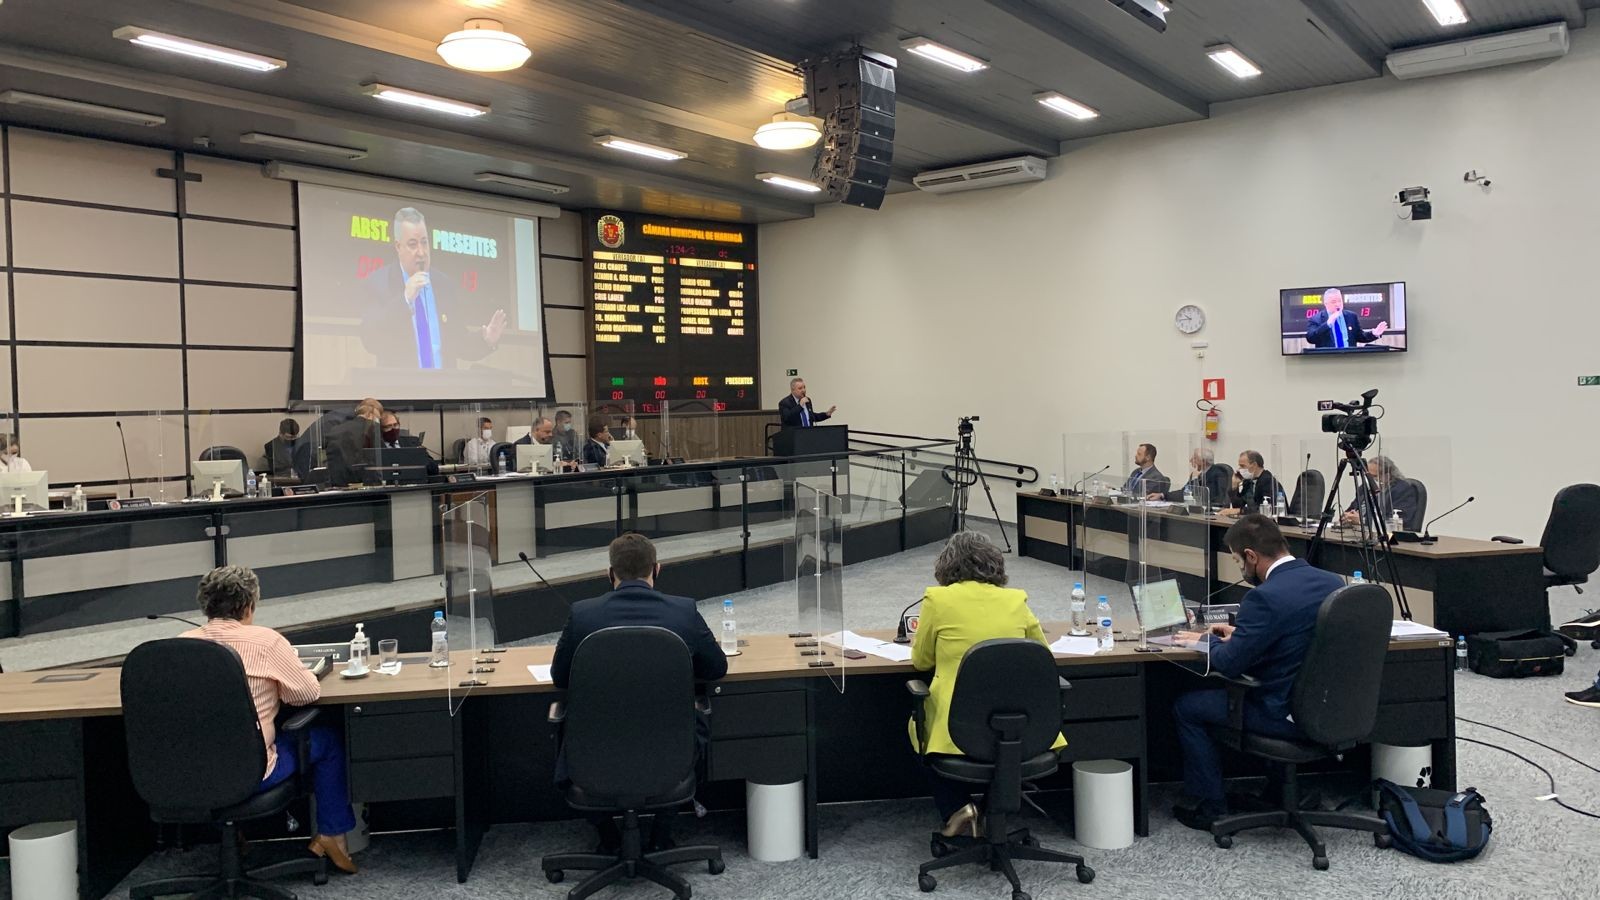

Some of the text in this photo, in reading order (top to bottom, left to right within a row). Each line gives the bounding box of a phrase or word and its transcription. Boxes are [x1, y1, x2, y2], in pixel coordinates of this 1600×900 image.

[351, 216, 390, 242] ABST.
[642, 224, 670, 236] CÂMARA
[670, 227, 705, 240] MUNICIPAL
[705, 231, 714, 240] DE
[432, 229, 498, 259] PRESENTES
[594, 262, 628, 271] ALEX CHAVES
[1344, 292, 1383, 303] PRESENTES
[1306, 308, 1319, 318] 00
[1361, 308, 1370, 317] 13
[724, 376, 754, 385] PRESENTES
[612, 391, 624, 400] 00
[656, 390, 665, 400] 00
[696, 390, 706, 398] 00
